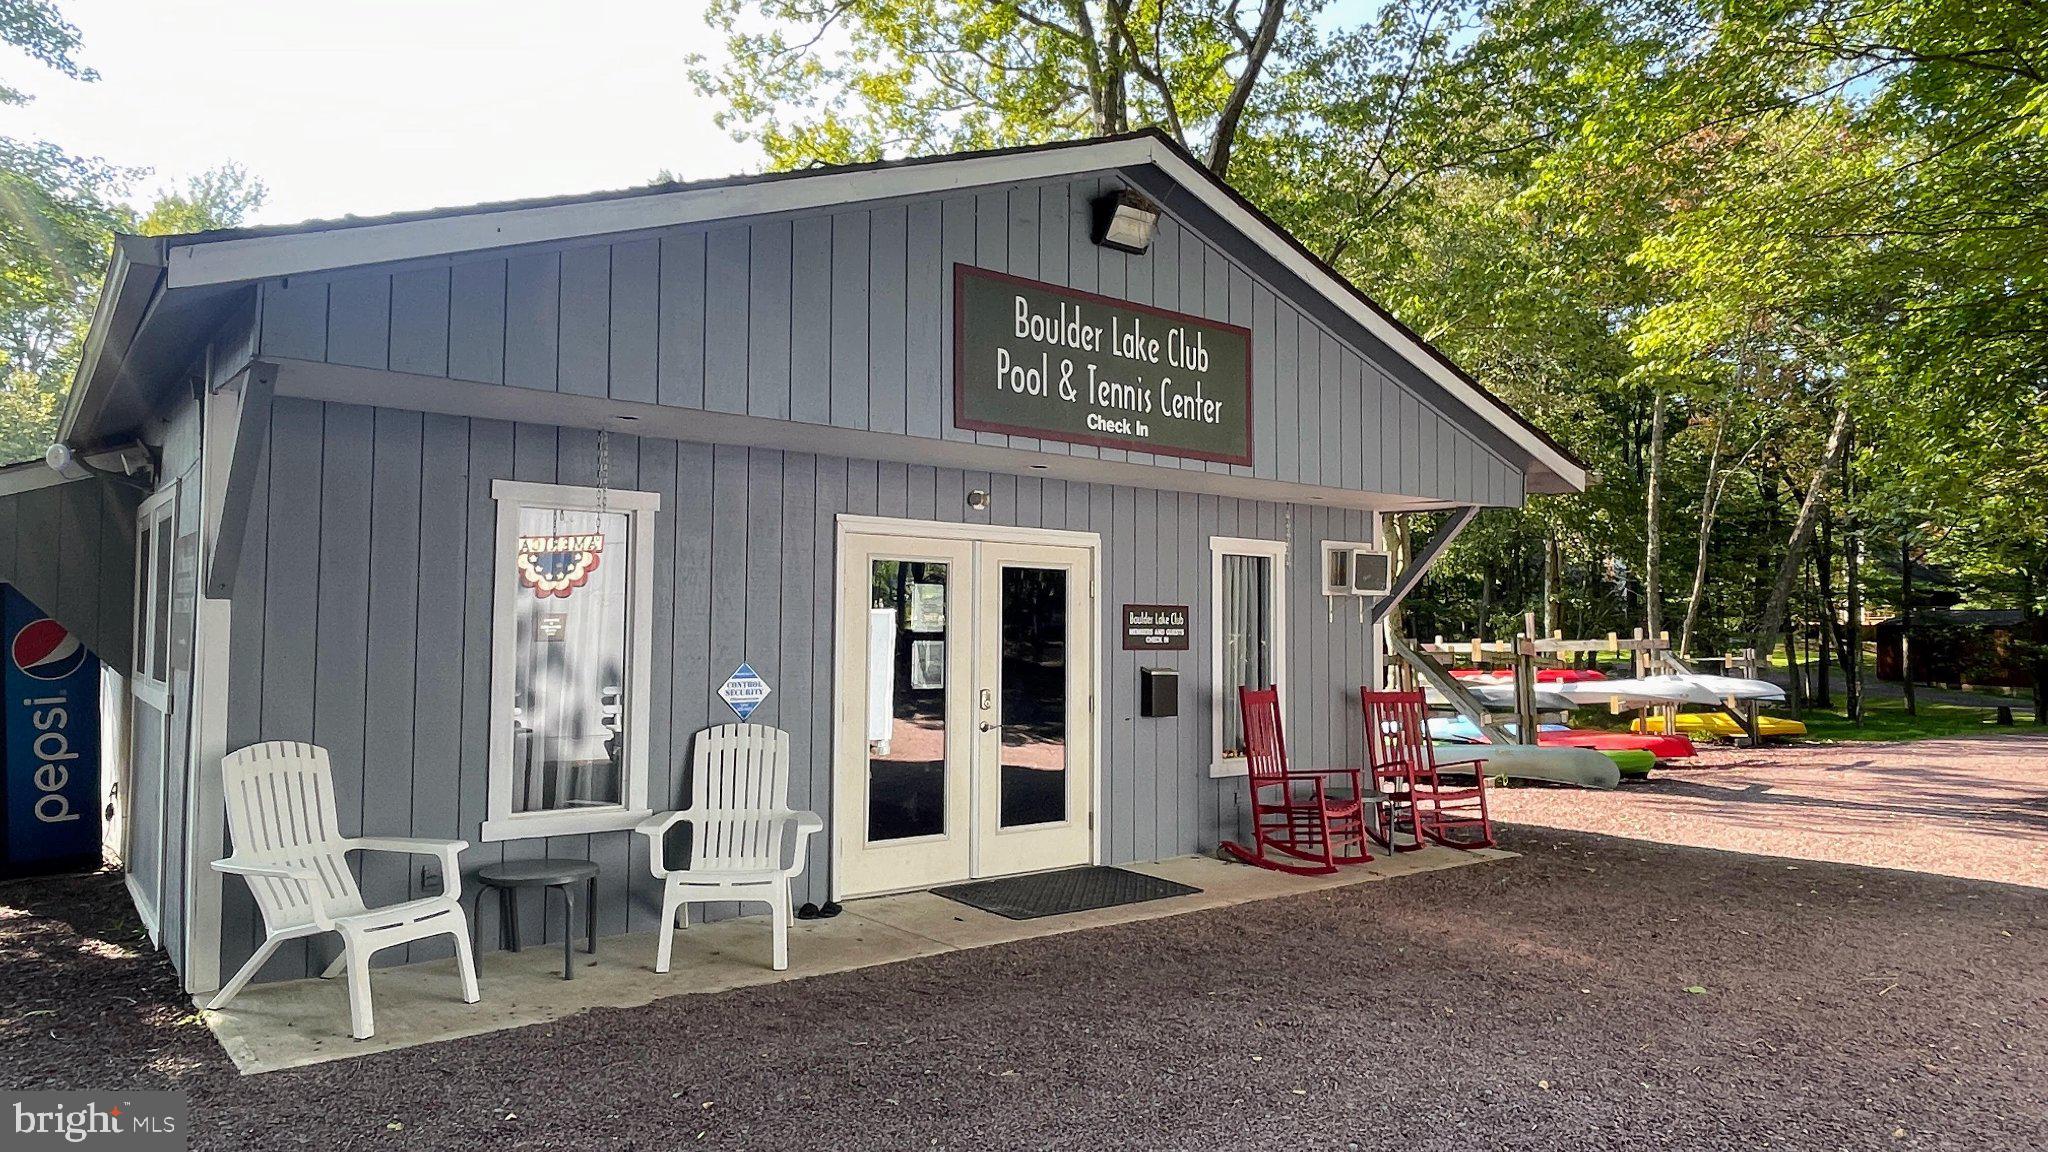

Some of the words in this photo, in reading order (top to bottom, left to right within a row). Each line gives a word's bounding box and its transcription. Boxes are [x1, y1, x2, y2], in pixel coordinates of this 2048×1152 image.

[1015, 295, 1103, 352] Boulder
[1112, 316, 1160, 364] Lake
[1168, 327, 1209, 373] Club
[997, 347, 1048, 397] Pool
[1058, 359, 1077, 403] &
[1087, 363, 1152, 414] Tennis
[1160, 377, 1222, 425] Center
[1087, 412, 1132, 436] Check
[1135, 420, 1149, 438] In
[1129, 611, 1153, 625] Boulder
[1155, 611, 1170, 625] Lake
[1170, 612, 1184, 625] Club
[725, 688, 764, 696] SECURITY
[24, 696, 80, 823] pepsi
